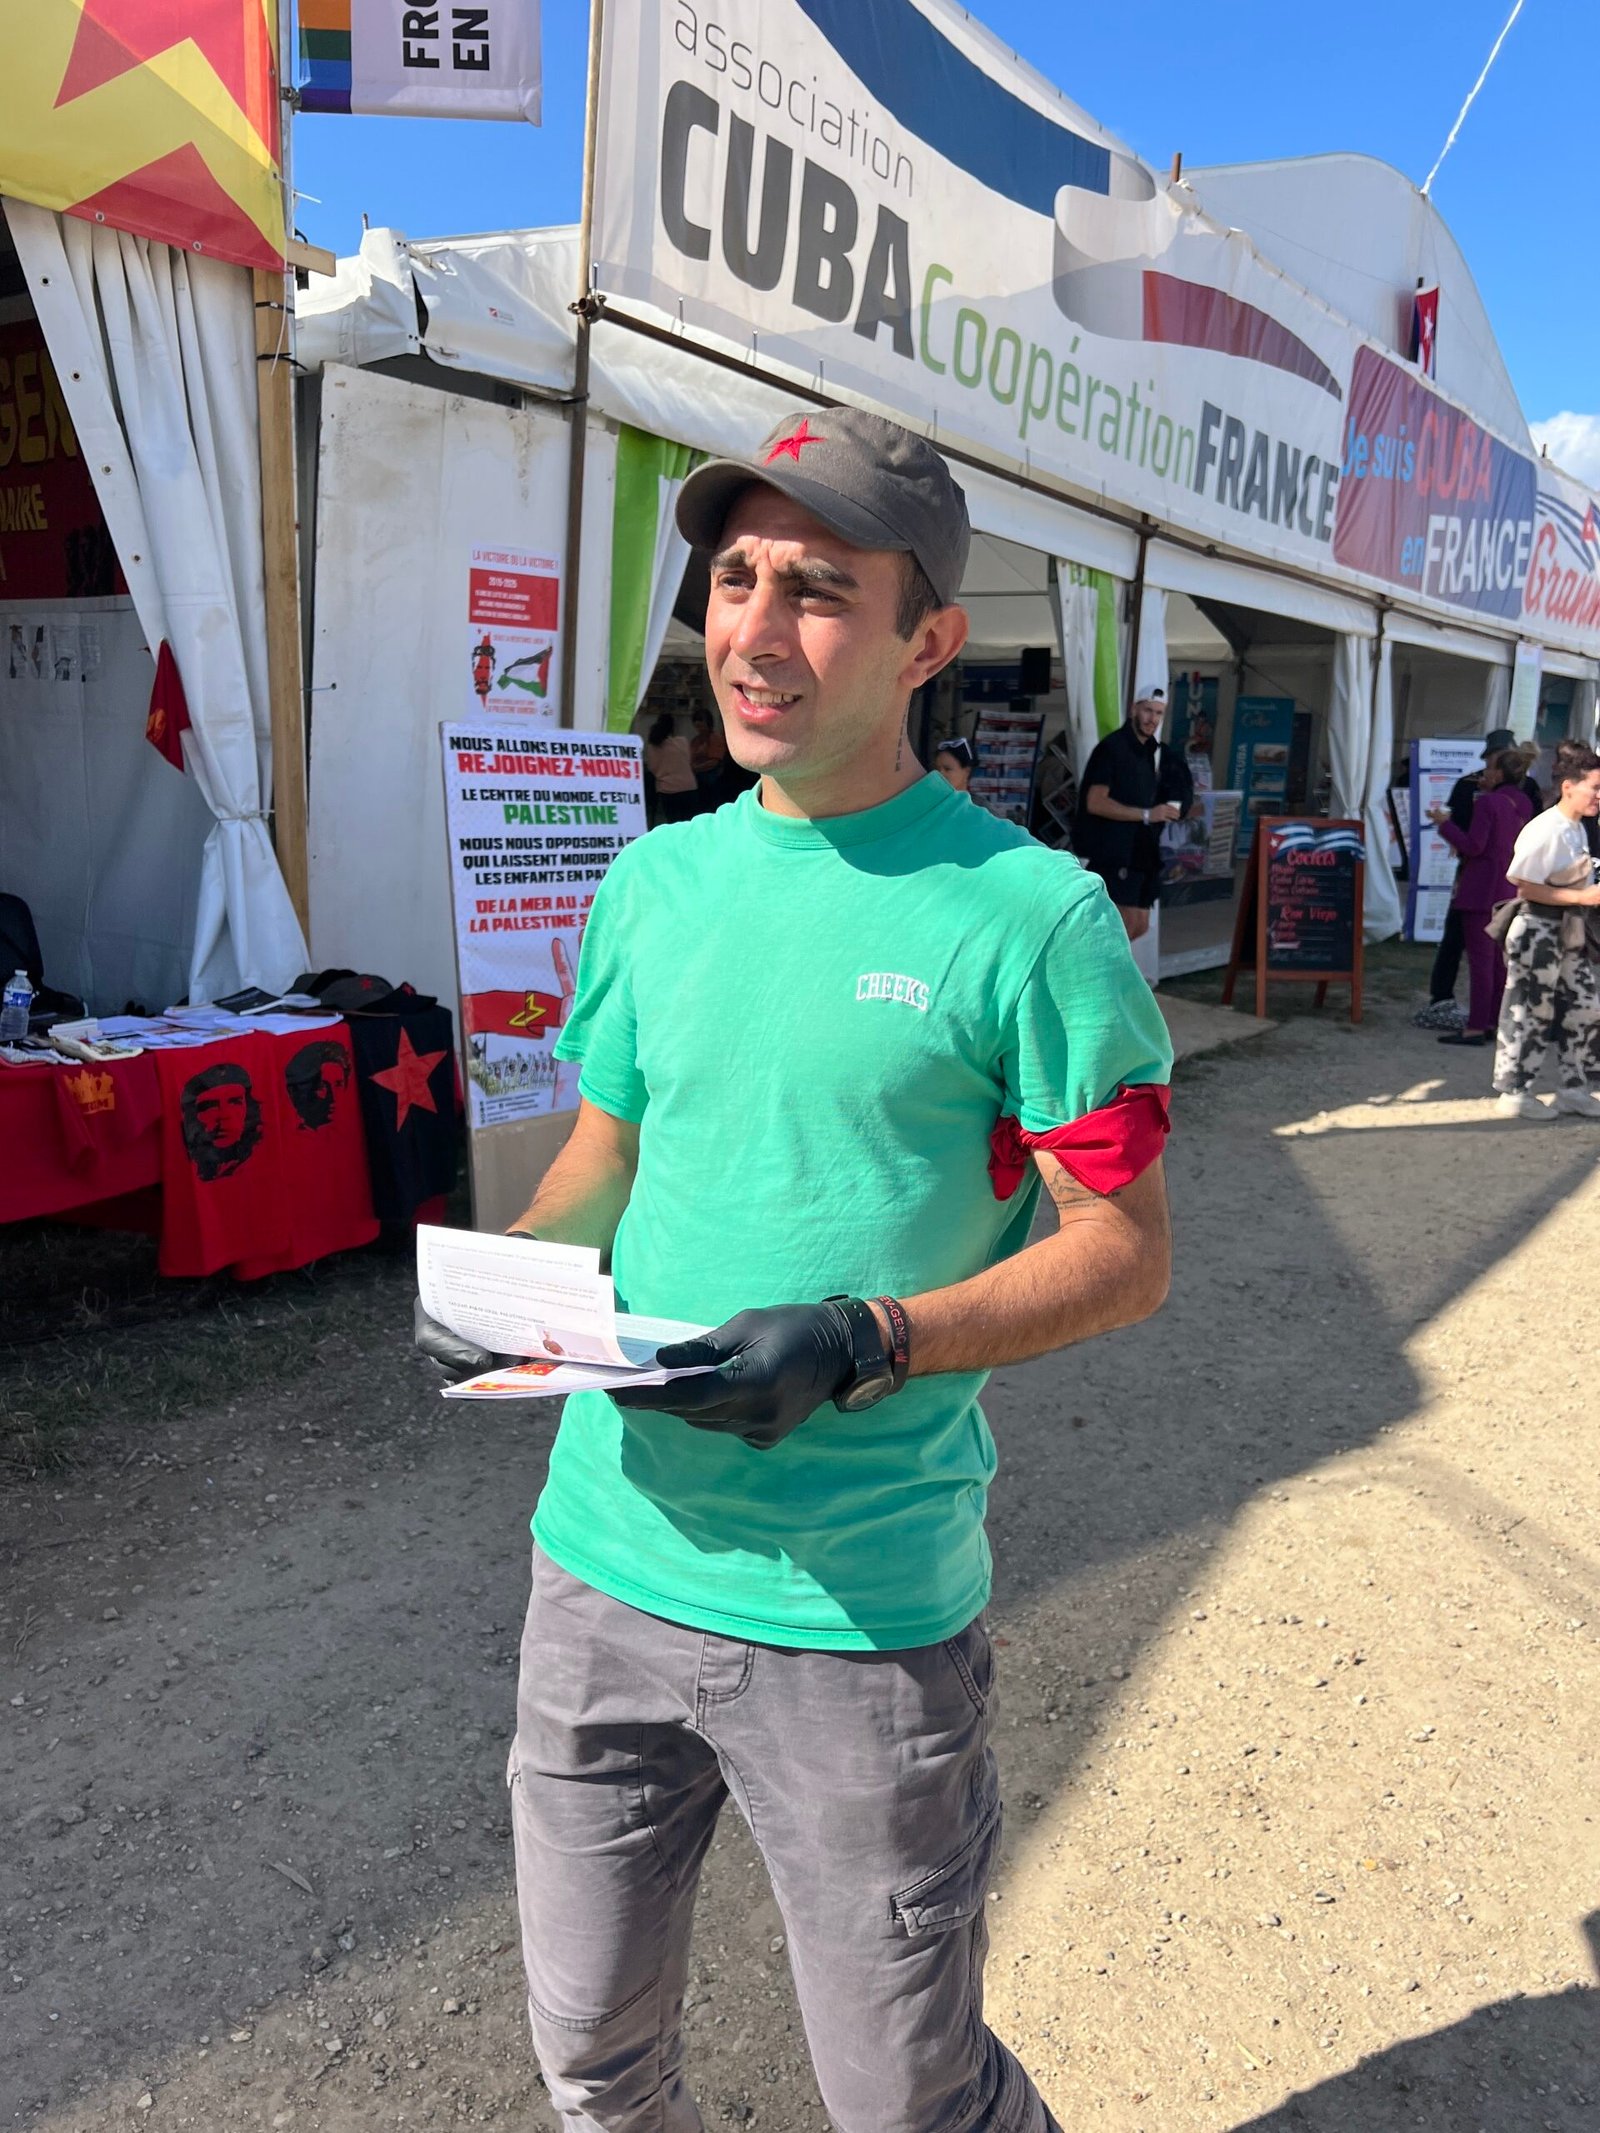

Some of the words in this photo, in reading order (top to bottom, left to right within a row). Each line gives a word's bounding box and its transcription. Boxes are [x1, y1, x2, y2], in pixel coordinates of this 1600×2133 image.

[402, 0, 439, 68] FR
[452, 8, 490, 71] EN
[675, 0, 914, 197] association
[660, 80, 915, 361] CUBA
[920, 262, 1194, 490] Coopération
[1194, 400, 1342, 544] FRANCE
[1341, 416, 1369, 480] Je
[1373, 423, 1415, 483] suis
[1415, 410, 1493, 502] CUBA
[1400, 536, 1425, 576] en
[1422, 514, 1532, 596] FRANCE
[449, 736, 493, 752] NOUS
[496, 739, 548, 754] ALLONS
[550, 742, 569, 755] EN
[572, 743, 637, 759] PALESTINE
[457, 752, 632, 779] REJOIGNEZ-NOUS
[461, 789, 477, 801] LE
[480, 789, 531, 802] CENTRE
[533, 790, 550, 802] DU
[628, 792, 640, 805] LA
[503, 804, 619, 825] PALESTINE
[459, 838, 504, 851] NOUS
[506, 837, 543, 850] NOUS
[545, 836, 615, 850] OPPOSONS
[462, 855, 490, 870] QUI
[492, 854, 557, 868] LAISSENT
[560, 852, 610, 867] MOURIR
[475, 872, 502, 886] LES
[504, 870, 566, 885] ENFANTS
[567, 870, 583, 882] EN
[475, 899, 497, 914] DE
[499, 898, 517, 912] LA
[520, 896, 553, 911] MER
[556, 895, 577, 909] AU
[470, 918, 489, 933] LA
[492, 914, 577, 931] PALESTINE
[856, 972, 930, 1012] CHEEKS
